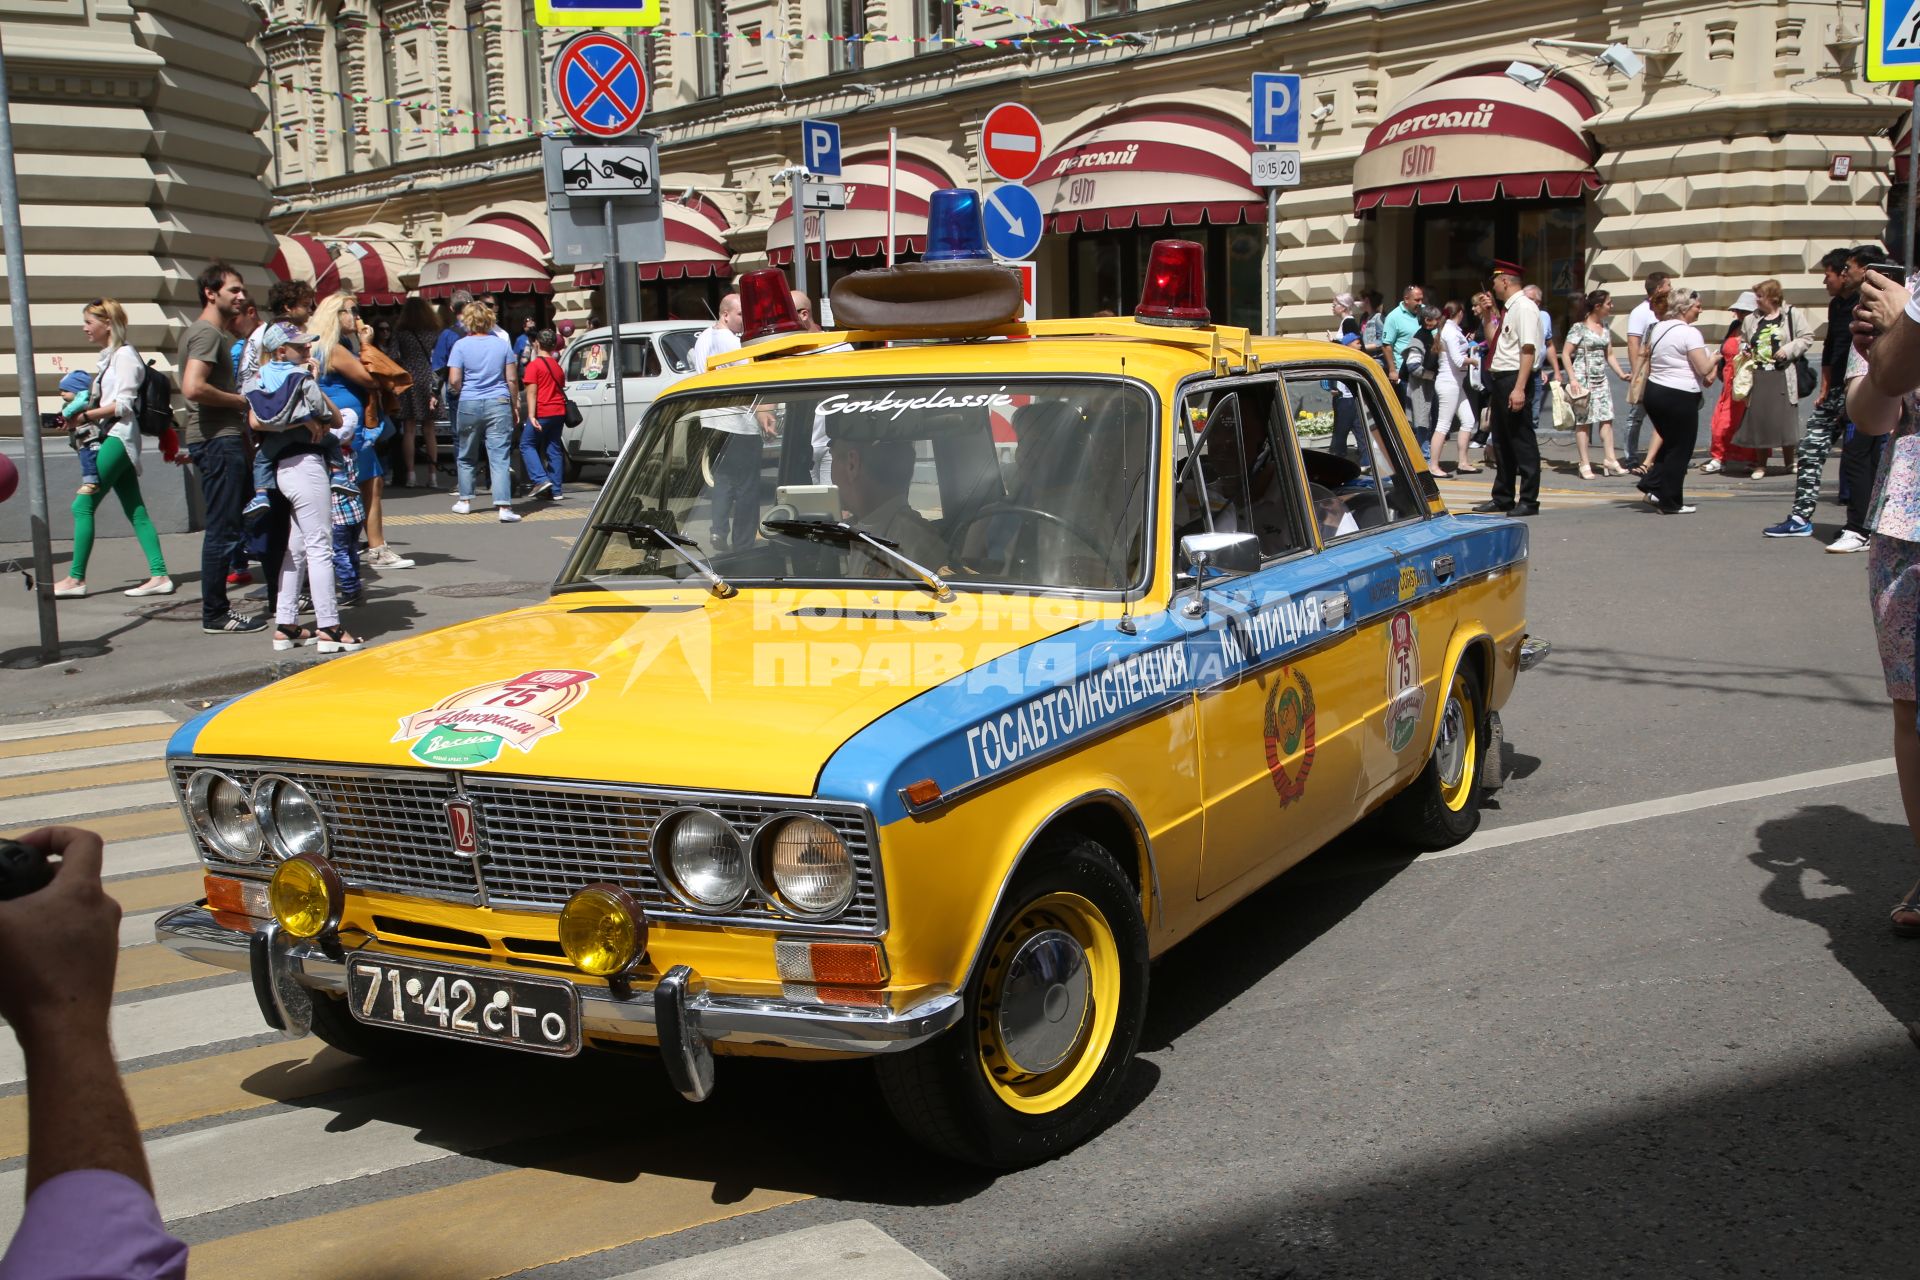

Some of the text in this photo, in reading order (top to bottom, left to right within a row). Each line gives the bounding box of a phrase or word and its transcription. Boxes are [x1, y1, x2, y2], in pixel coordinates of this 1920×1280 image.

[1265, 82, 1290, 135] P
[811, 128, 832, 168] P
[1400, 144, 1436, 177] ГУМ
[1258, 160, 1295, 175] 10 15 20
[1069, 178, 1096, 205] ГУМ
[966, 596, 1321, 779] ГОСАВТОИНСПЕКЦИЯ МИЛИЦИЯ
[1397, 654, 1411, 689] 75
[483, 686, 546, 707] 75
[424, 734, 497, 755] Весна
